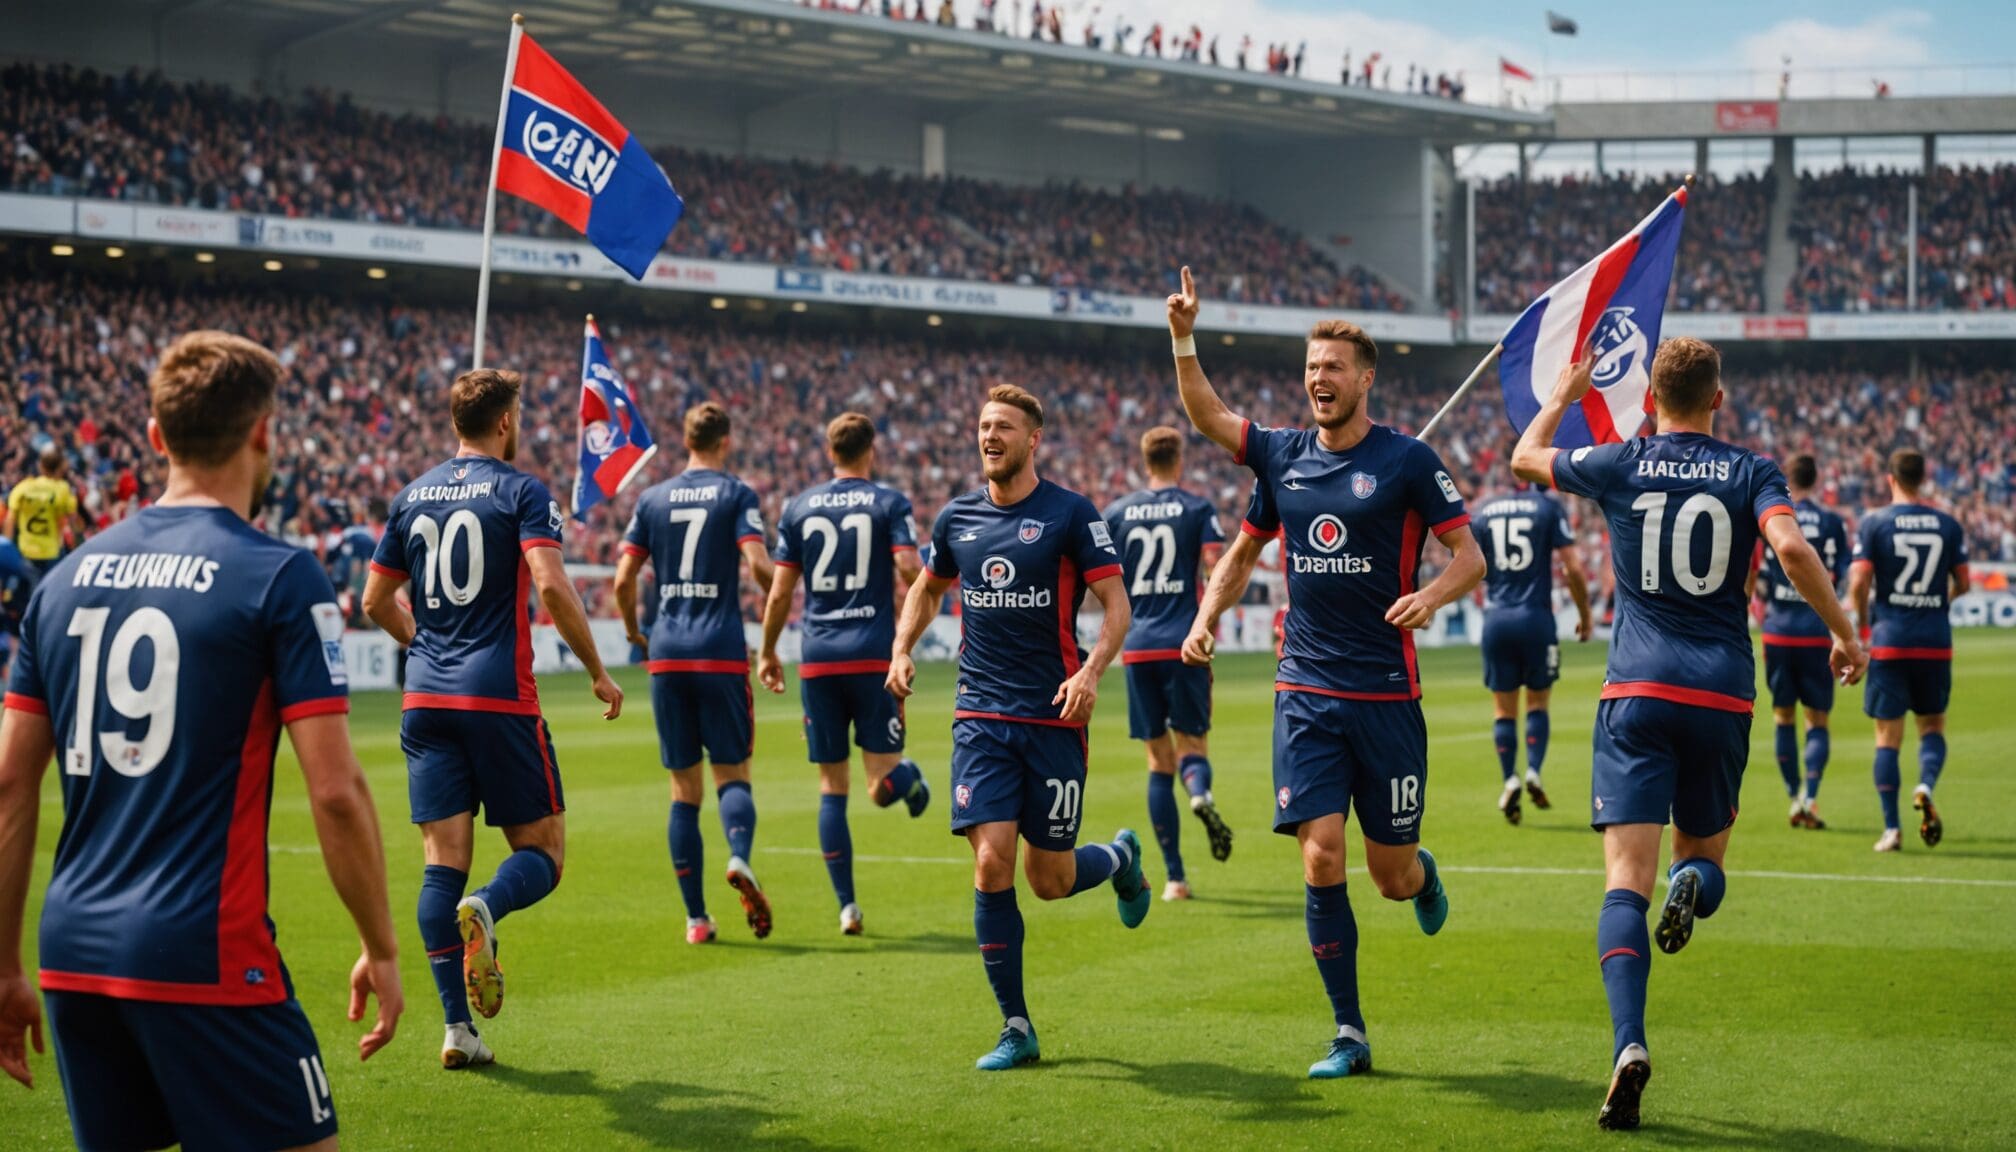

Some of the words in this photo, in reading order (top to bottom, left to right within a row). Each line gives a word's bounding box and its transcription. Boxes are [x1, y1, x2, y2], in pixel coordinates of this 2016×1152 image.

[670, 508, 708, 581] 7
[802, 513, 873, 592] 21
[1126, 523, 1177, 596] 22
[1488, 517, 1534, 572] 15
[1632, 491, 1732, 596] 10
[66, 607, 180, 777] 19
[1046, 779, 1080, 820] 20
